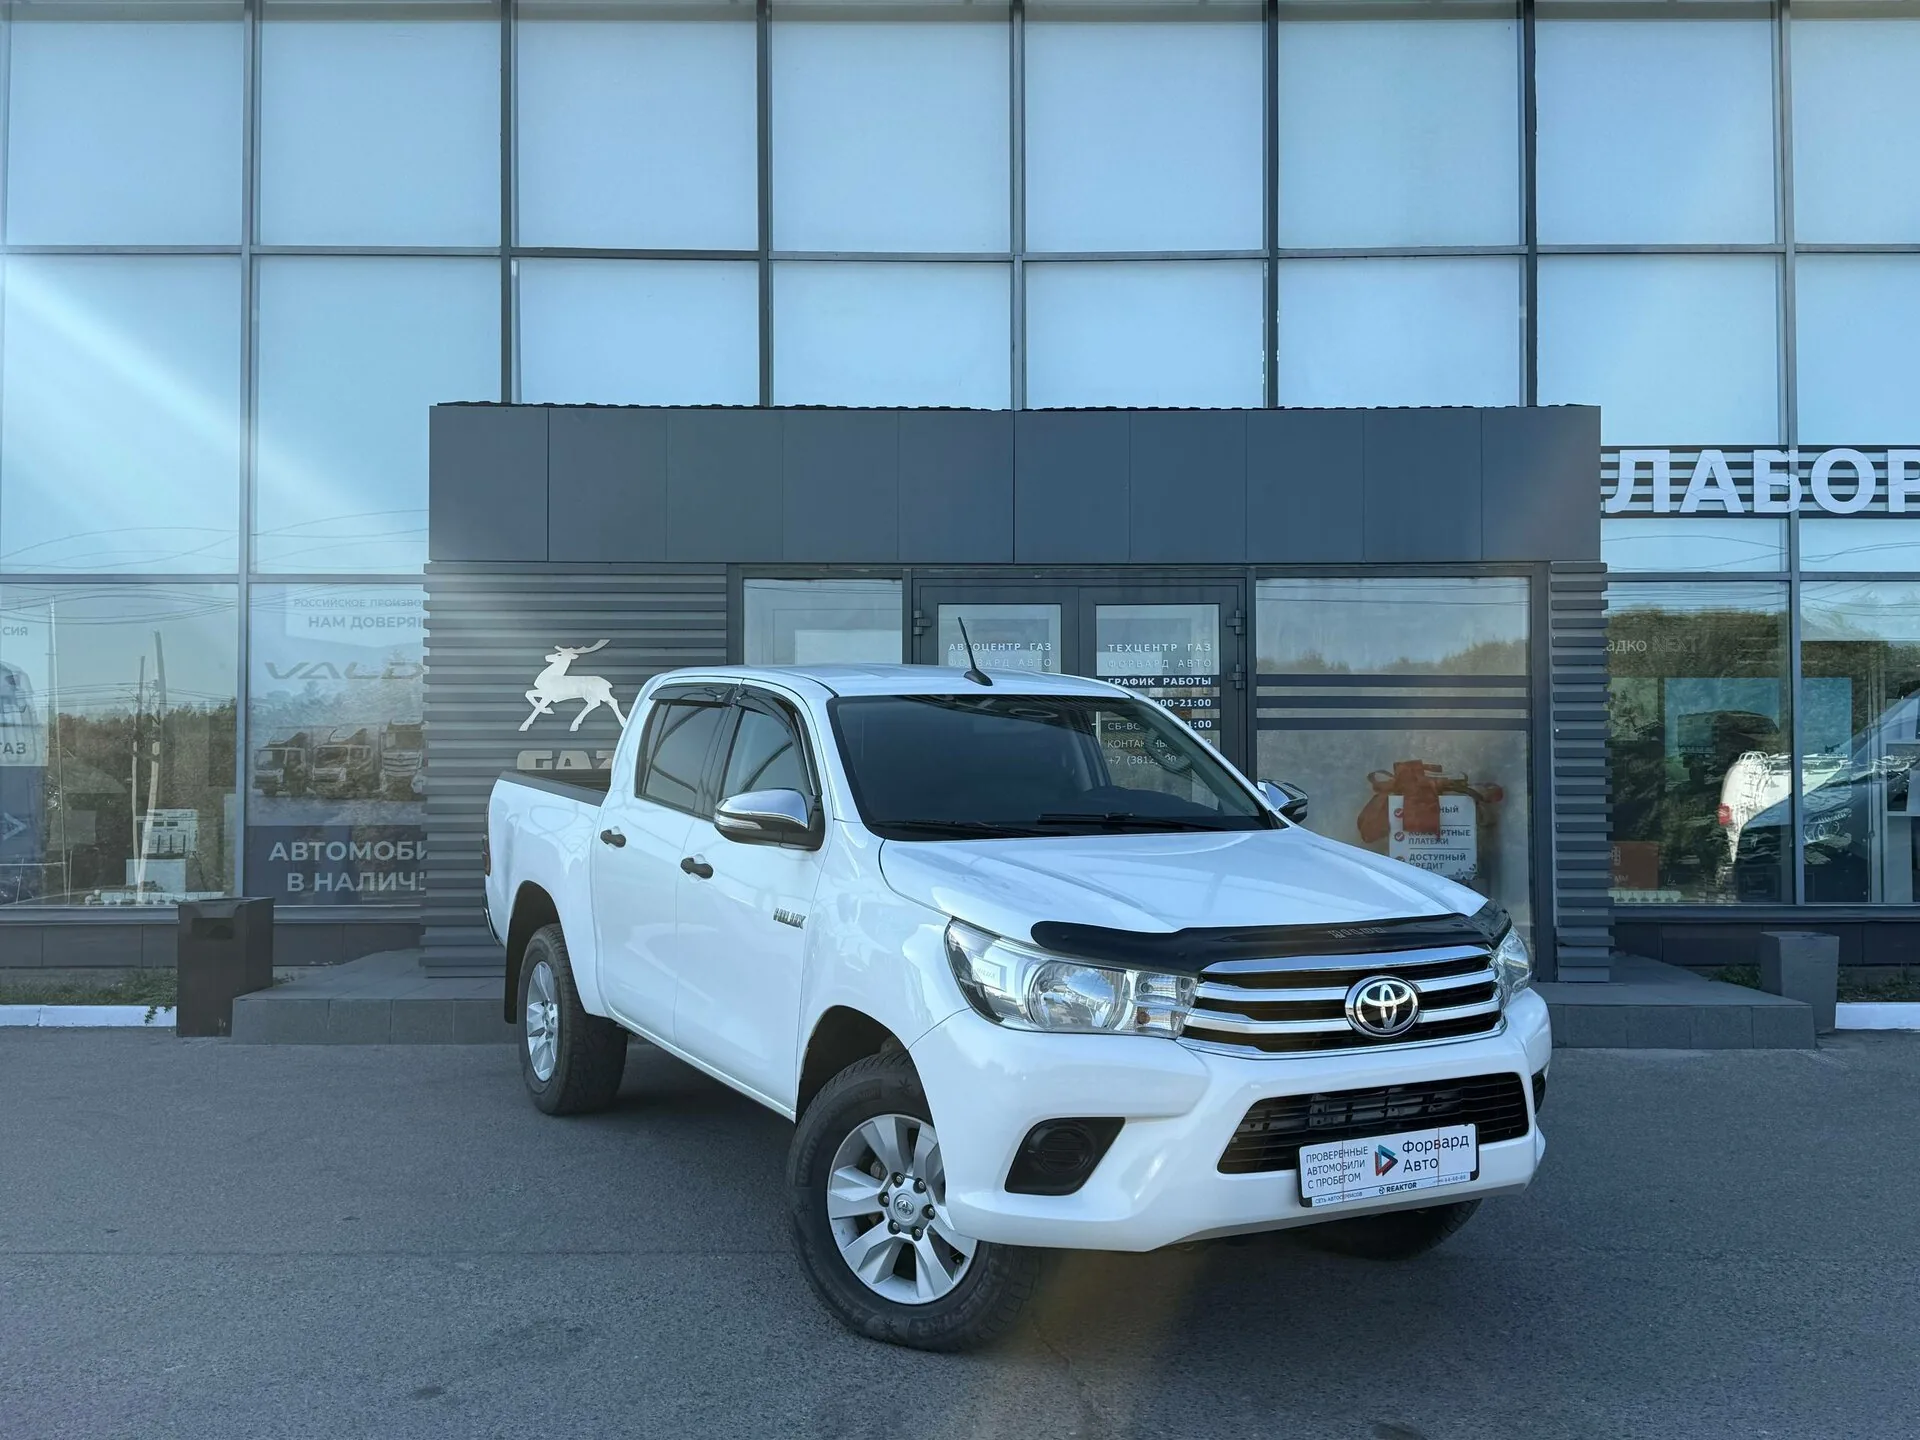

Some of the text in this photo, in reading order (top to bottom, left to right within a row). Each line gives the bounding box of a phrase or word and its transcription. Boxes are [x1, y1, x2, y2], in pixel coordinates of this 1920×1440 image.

[293, 597, 366, 608] РОССИЙСКОЕ
[308, 616, 346, 628] НАМ
[948, 643, 1052, 652] АВОЦЕНТР ГАЗ
[1107, 643, 1212, 653] ТЕХЦЕНТР ГАЗ
[948, 658, 1053, 668] ФОВАРД АВТО
[1107, 659, 1212, 668] ФОРВАРД АВТО
[1108, 677, 1212, 686] ГРАФИК РАБОТЫ
[516, 750, 616, 770] GAZ
[1108, 756, 1121, 765] +7
[1409, 852, 1467, 862] ДОСТУПНЫЙ
[287, 872, 305, 892] В
[1402, 1135, 1470, 1155] Форвард
[1306, 1146, 1369, 1163] ПРОВЕРЕННЫЕ
[1307, 1159, 1366, 1176] АВТОМОБИЛИ
[1403, 1157, 1439, 1173] Авто
[1307, 1172, 1362, 1189] С ПРОБЕГОМ
[1386, 1182, 1418, 1193] REAKTOR
